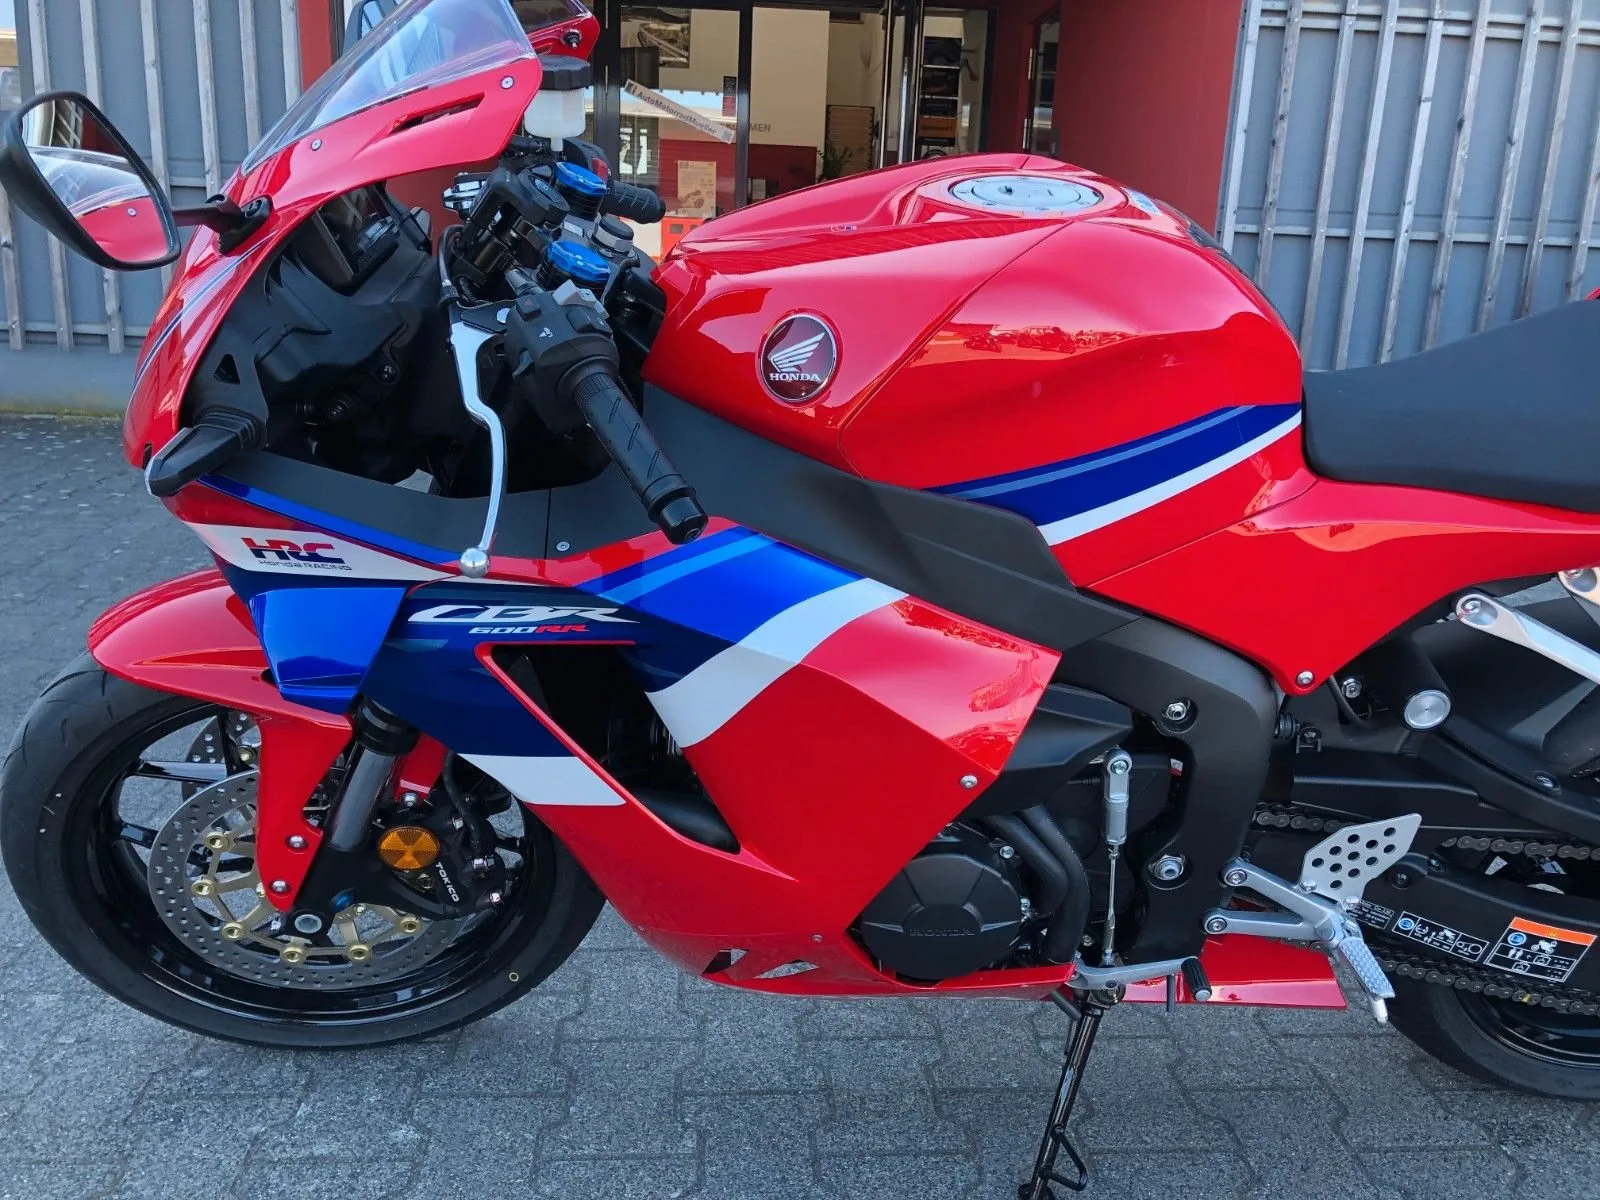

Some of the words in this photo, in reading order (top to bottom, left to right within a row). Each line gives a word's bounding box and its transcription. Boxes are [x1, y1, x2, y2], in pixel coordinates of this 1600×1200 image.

[637, 91, 718, 135] AutoMotorradMueller
[769, 373, 822, 382] HONDA
[240, 537, 346, 565] HRC
[258, 559, 303, 569] Honda
[303, 562, 353, 571] RACING
[407, 604, 641, 624] CBR
[468, 624, 591, 635] 600RR
[435, 862, 460, 902] TOKICO
[909, 928, 976, 937] HONDA
